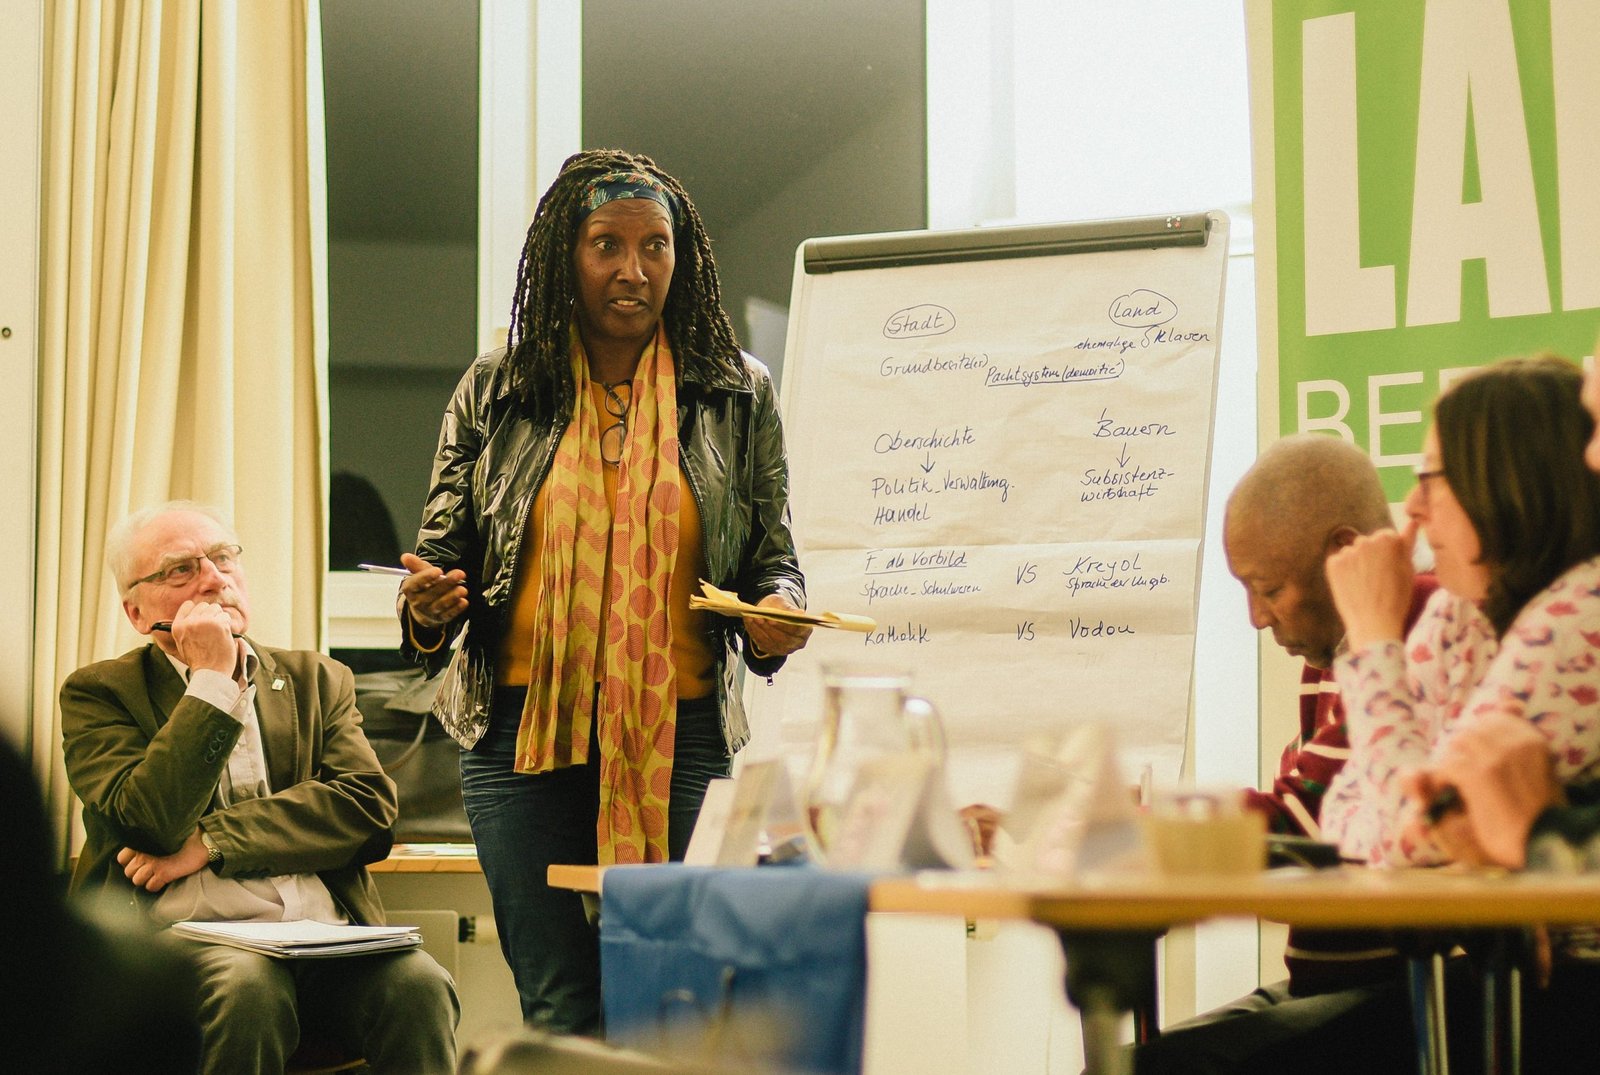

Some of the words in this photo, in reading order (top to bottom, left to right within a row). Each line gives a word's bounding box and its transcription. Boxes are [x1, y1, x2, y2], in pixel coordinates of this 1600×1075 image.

[1113, 301, 1162, 319] Land
[887, 311, 945, 335] Stadt
[1073, 337, 1137, 354] ehemalige
[1140, 324, 1210, 349] Sklaven
[873, 425, 976, 454] Oberschichte
[1092, 418, 1177, 438] Bauern
[872, 476, 933, 498] Politik
[873, 503, 932, 526] Handel
[912, 550, 968, 568] Vorbild
[1069, 616, 1136, 640] Vodou
